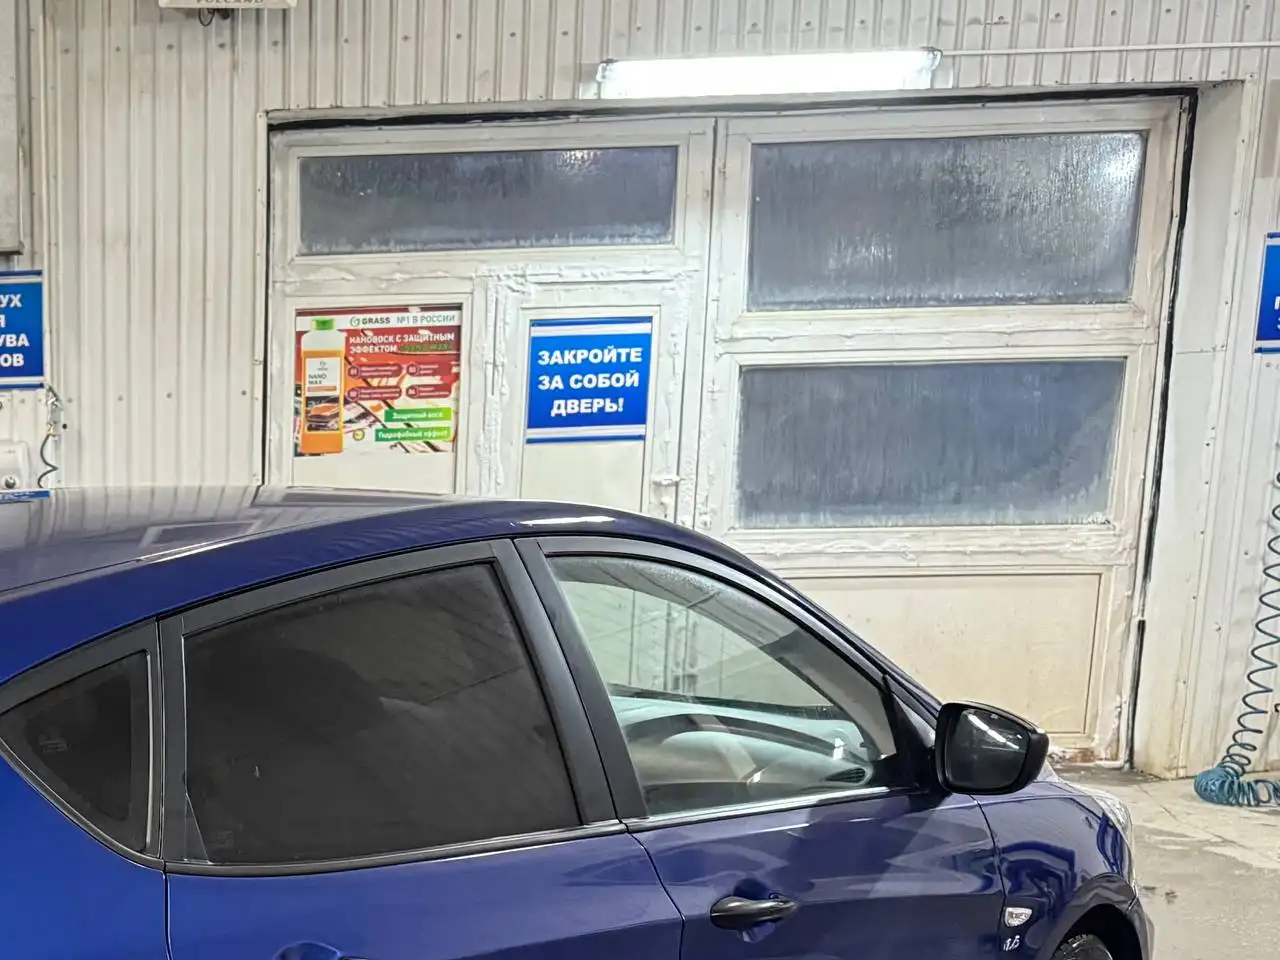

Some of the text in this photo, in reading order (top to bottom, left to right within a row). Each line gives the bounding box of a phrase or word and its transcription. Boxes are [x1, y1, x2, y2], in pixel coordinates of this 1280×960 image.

[362, 317, 391, 325] GRASS
[421, 314, 456, 323] РОССИИ
[349, 335, 394, 345] НАНОВОСК
[402, 332, 455, 343] ЗАЩИТНЫМ
[349, 344, 397, 354] ЭФФЕКТОМ
[537, 345, 643, 365] ЗАКРОЙТЕ
[537, 369, 639, 390] ЗА СОБОЙ
[550, 397, 624, 417] ДВЕРЬ!
